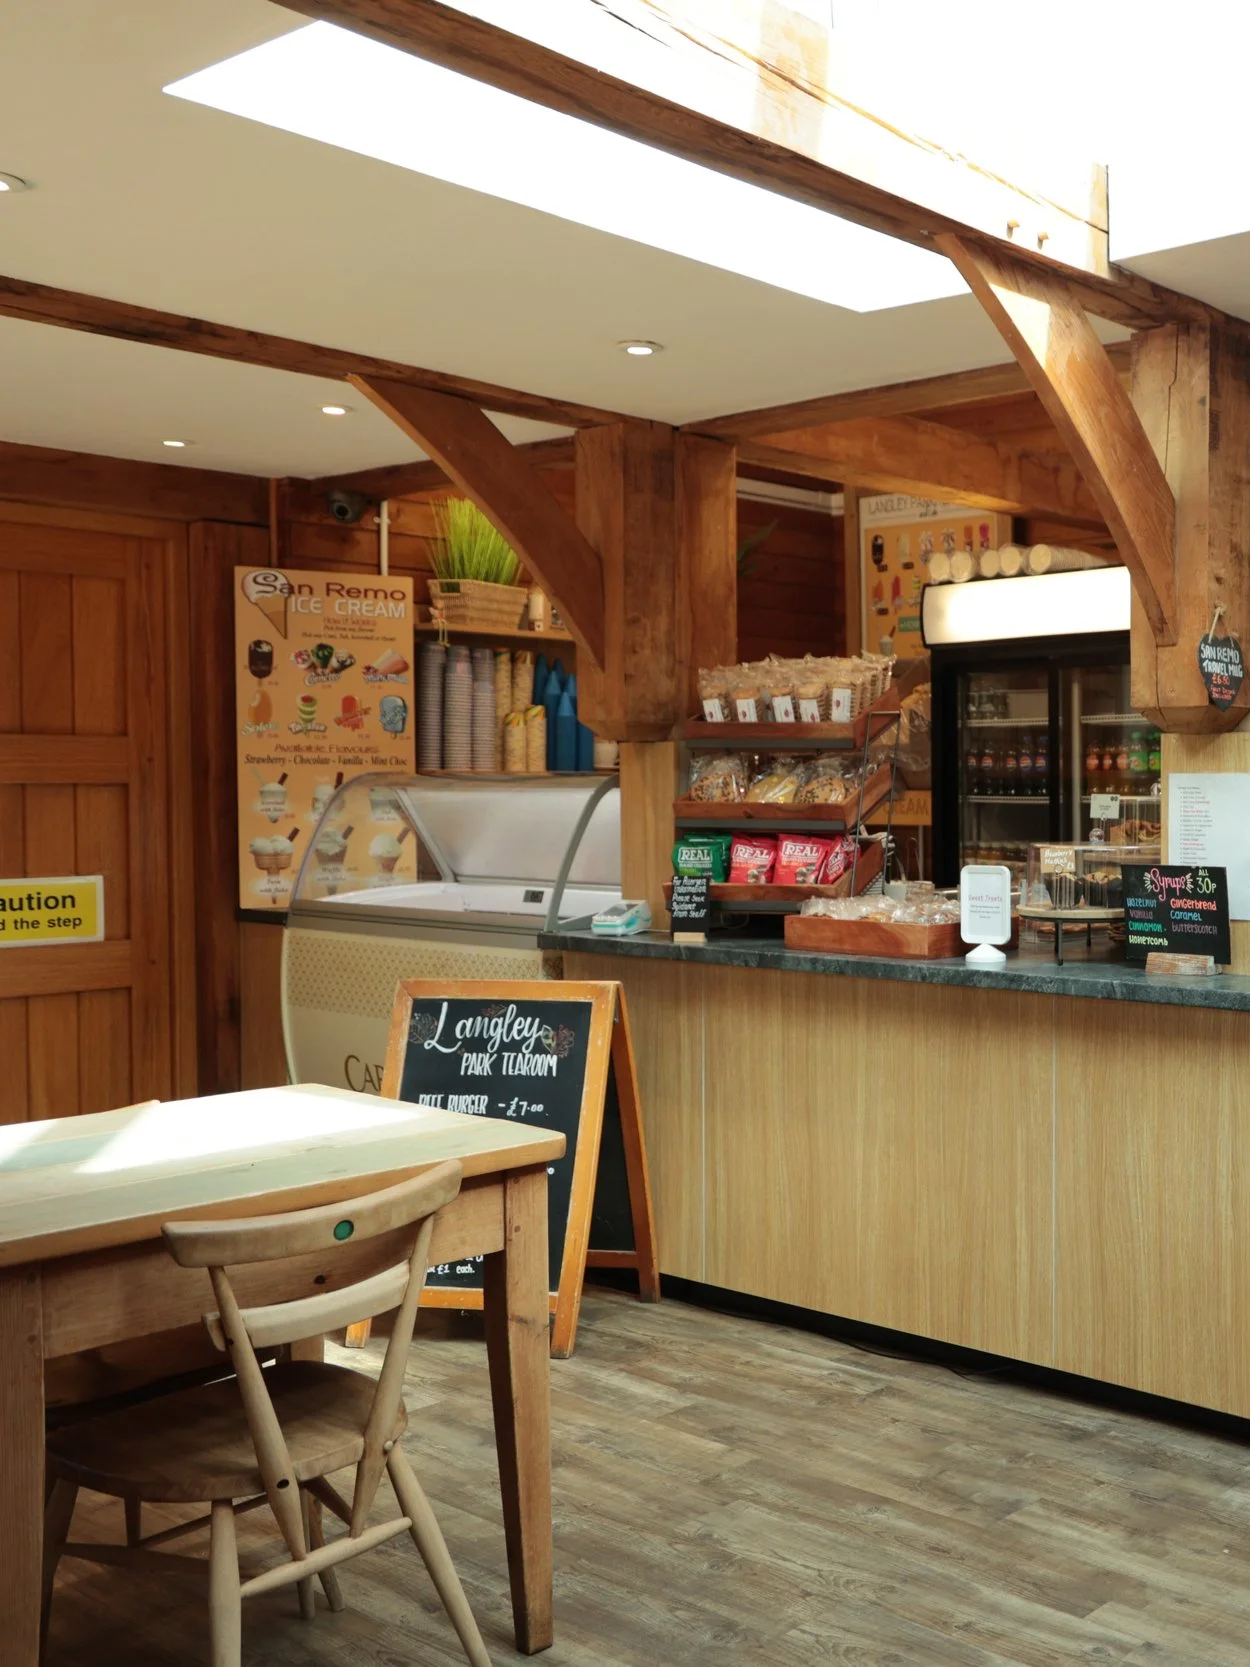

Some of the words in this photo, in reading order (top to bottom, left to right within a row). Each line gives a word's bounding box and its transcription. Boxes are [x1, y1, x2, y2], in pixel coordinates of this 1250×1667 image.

[252, 571, 313, 599] San
[326, 582, 407, 601] Remo
[291, 596, 323, 614] ICE
[334, 598, 406, 619] CREAM
[1200, 643, 1216, 660] SAN
[1216, 647, 1240, 664] REMO
[1202, 659, 1228, 676] TRAVEL
[1228, 663, 1243, 678] MUG
[244, 754, 287, 768] Strawberry
[293, 754, 331, 766] Chocolate
[338, 755, 364, 767] Vanilla
[370, 756, 388, 766] Mint
[389, 755, 408, 767] Choc
[680, 849, 711, 861] REAL
[785, 843, 819, 857] REAL
[1150, 867, 1187, 902] Syrups
[0, 892, 76, 912] aution
[14, 918, 41, 930] the
[47, 917, 83, 930] step
[424, 1001, 543, 1053] Langley
[460, 1051, 498, 1076] PARK
[501, 1051, 558, 1078] TEAROOM
[447, 1094, 489, 1115] BURGER
